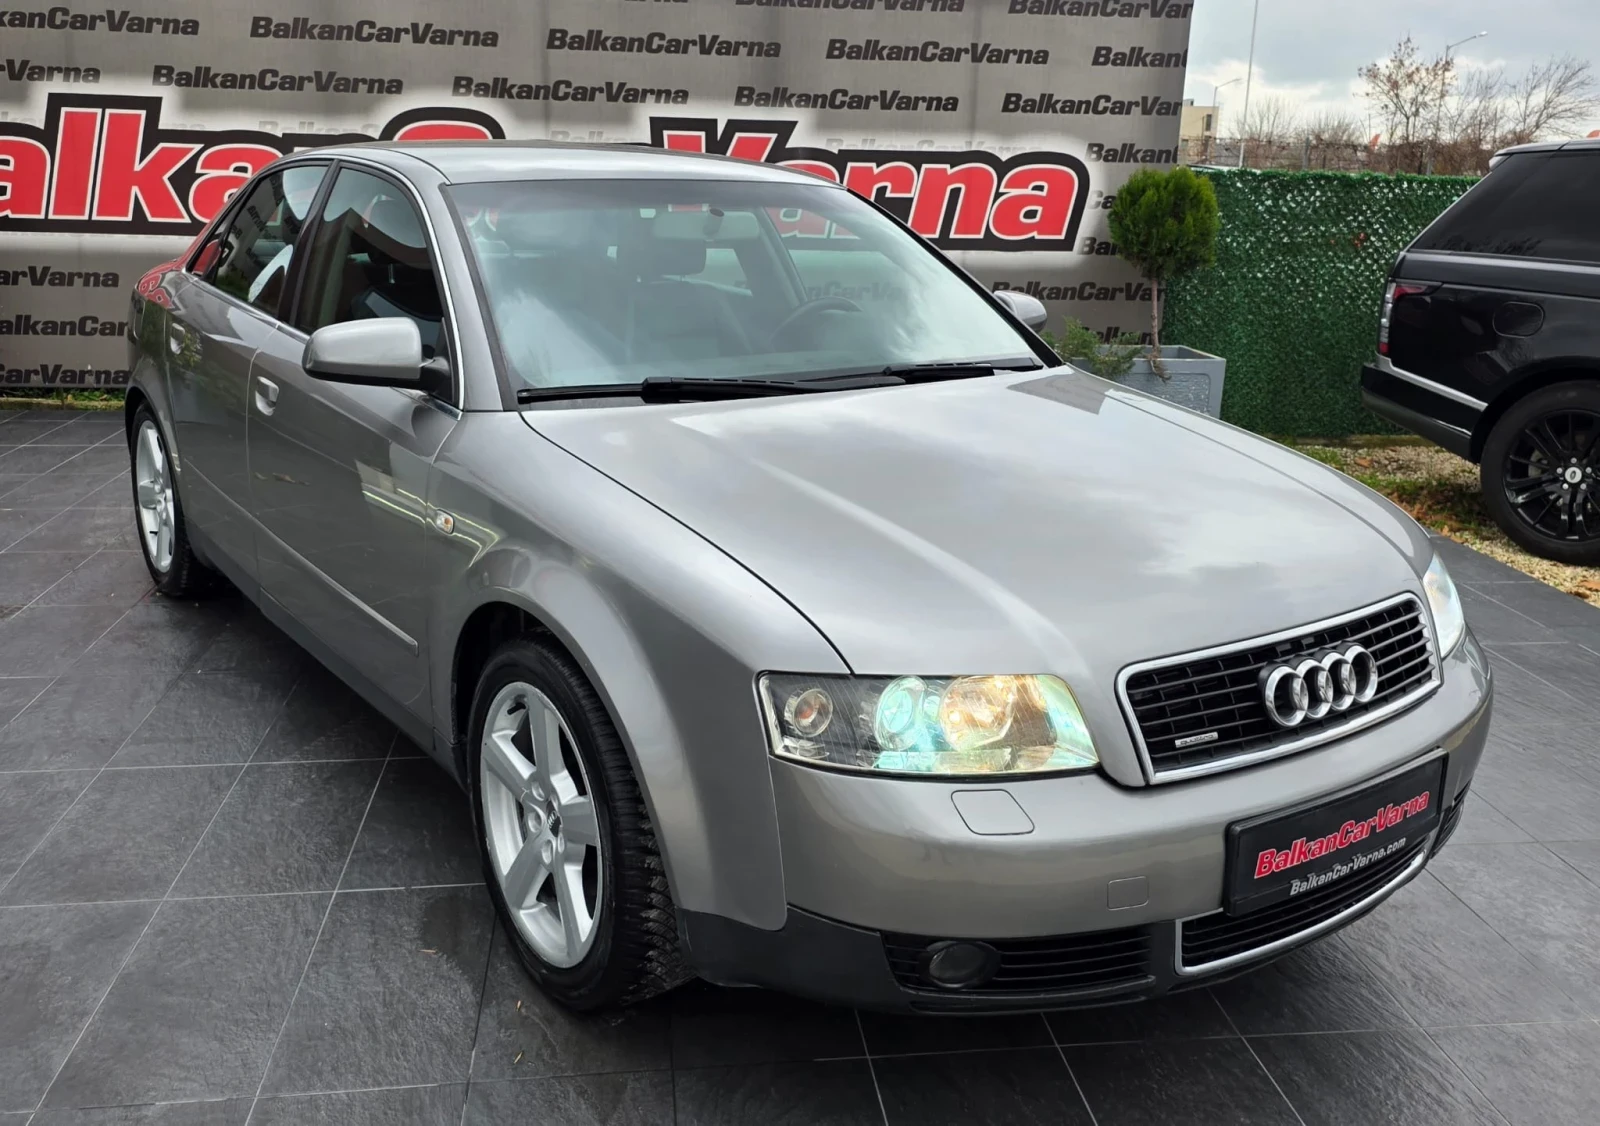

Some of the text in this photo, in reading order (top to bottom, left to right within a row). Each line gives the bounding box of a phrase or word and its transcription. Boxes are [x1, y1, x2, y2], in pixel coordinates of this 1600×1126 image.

[0, 7, 200, 36] anCarVarna
[250, 16, 499, 47] BalkanCarVarna
[546, 28, 782, 58] BalkanCarVarna
[826, 38, 1050, 65] BalkanCarVarna
[1091, 46, 1188, 68] Balkan
[152, 65, 404, 95] BalkanCarVarna
[452, 76, 689, 105] BalkanCarVarna
[734, 85, 960, 112] BalkanCarVarna
[1084, 142, 1178, 164] Balkan
[0, 363, 132, 385] arVarna
[1254, 791, 1430, 879] BalkanCarVarna
[1290, 837, 1406, 896] BalkanCarVarna.com
